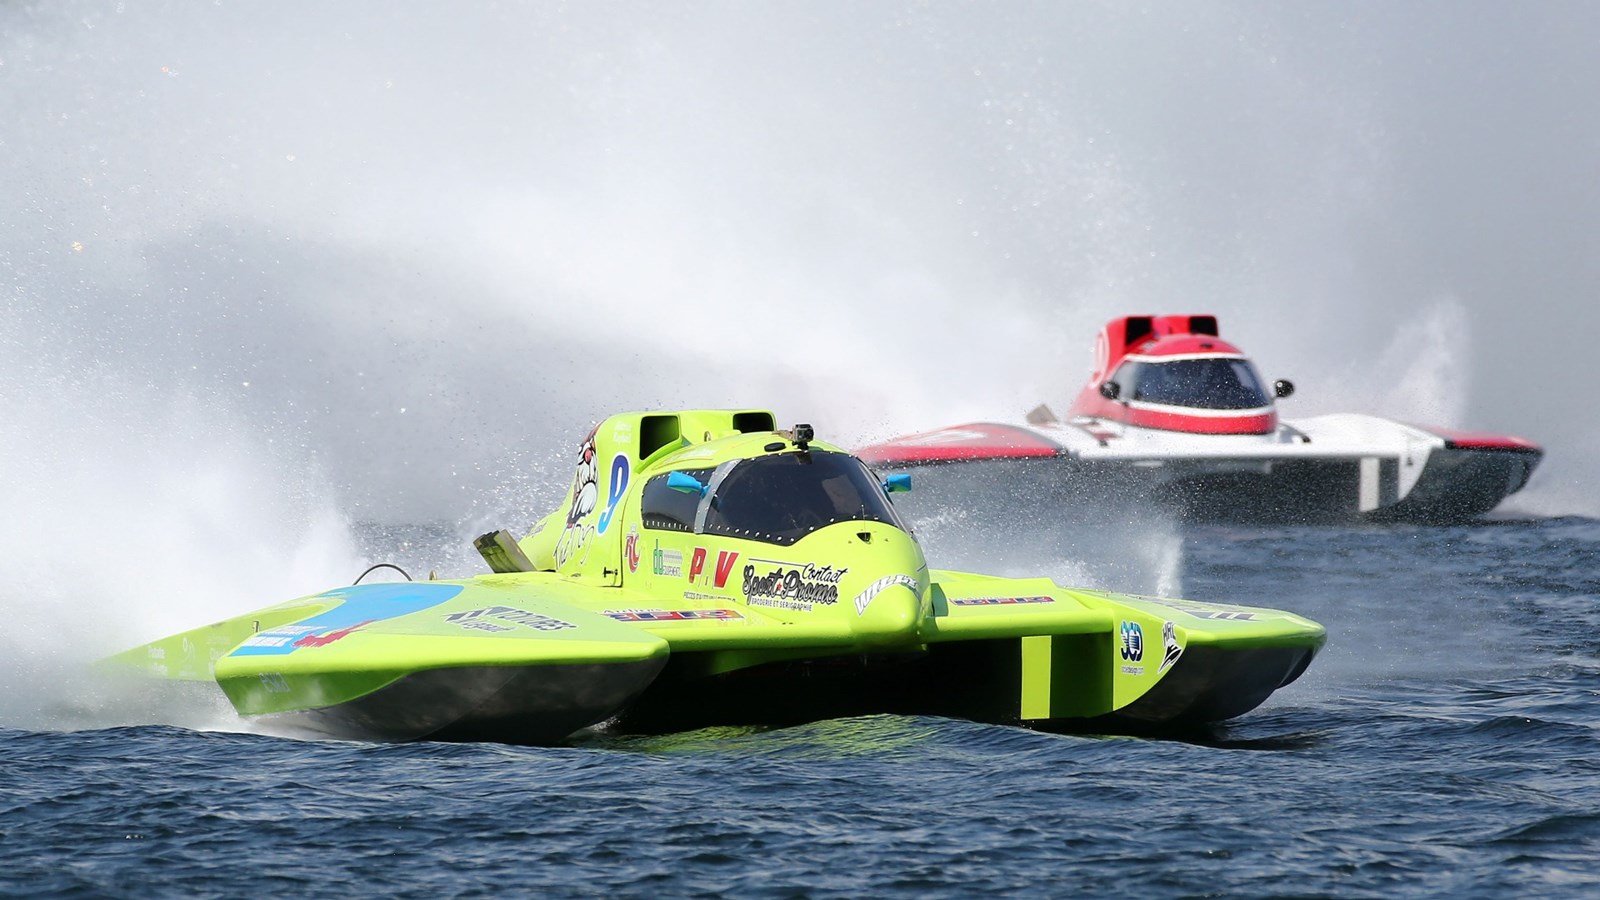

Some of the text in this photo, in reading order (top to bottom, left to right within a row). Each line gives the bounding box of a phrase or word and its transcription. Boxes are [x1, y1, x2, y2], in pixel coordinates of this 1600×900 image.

[598, 454, 630, 534] 9
[742, 564, 838, 606] Sport Promo
[802, 563, 848, 583] Contact
